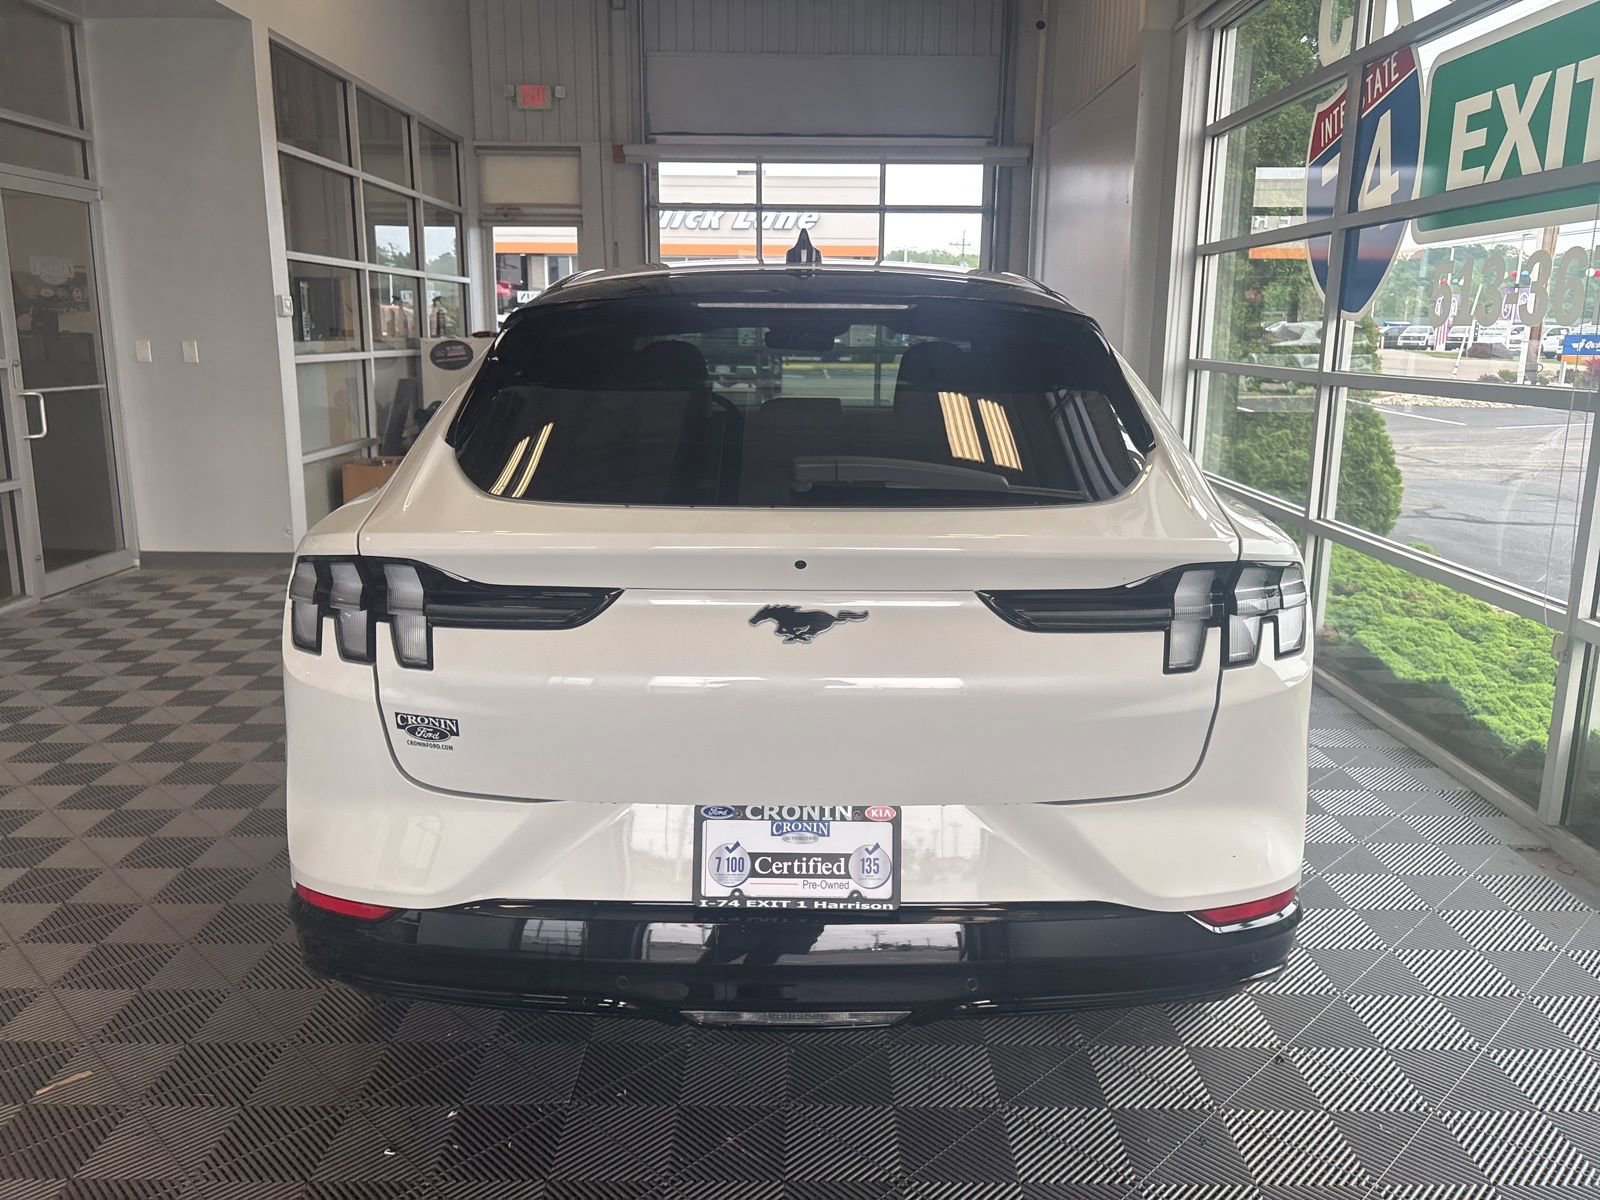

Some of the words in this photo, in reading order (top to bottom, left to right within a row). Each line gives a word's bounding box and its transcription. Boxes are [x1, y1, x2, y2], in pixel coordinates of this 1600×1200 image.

[1320, 50, 1400, 148] INTETATE
[1446, 55, 1600, 191] EXIT
[659, 210, 724, 229] uick
[397, 714, 457, 733] CRONIN
[415, 726, 440, 740] Ford
[707, 806, 729, 816] Ford
[745, 804, 853, 821] CRONIN
[871, 808, 892, 818] KIA
[772, 821, 829, 836] CRONIN
[754, 856, 846, 875] Certified
[859, 857, 880, 875] 135
[802, 880, 849, 890] Pre-Owned
[699, 899, 740, 908] I-74
[746, 900, 791, 909] EXIT
[797, 901, 807, 909] 1
[813, 902, 894, 911] Harrison
